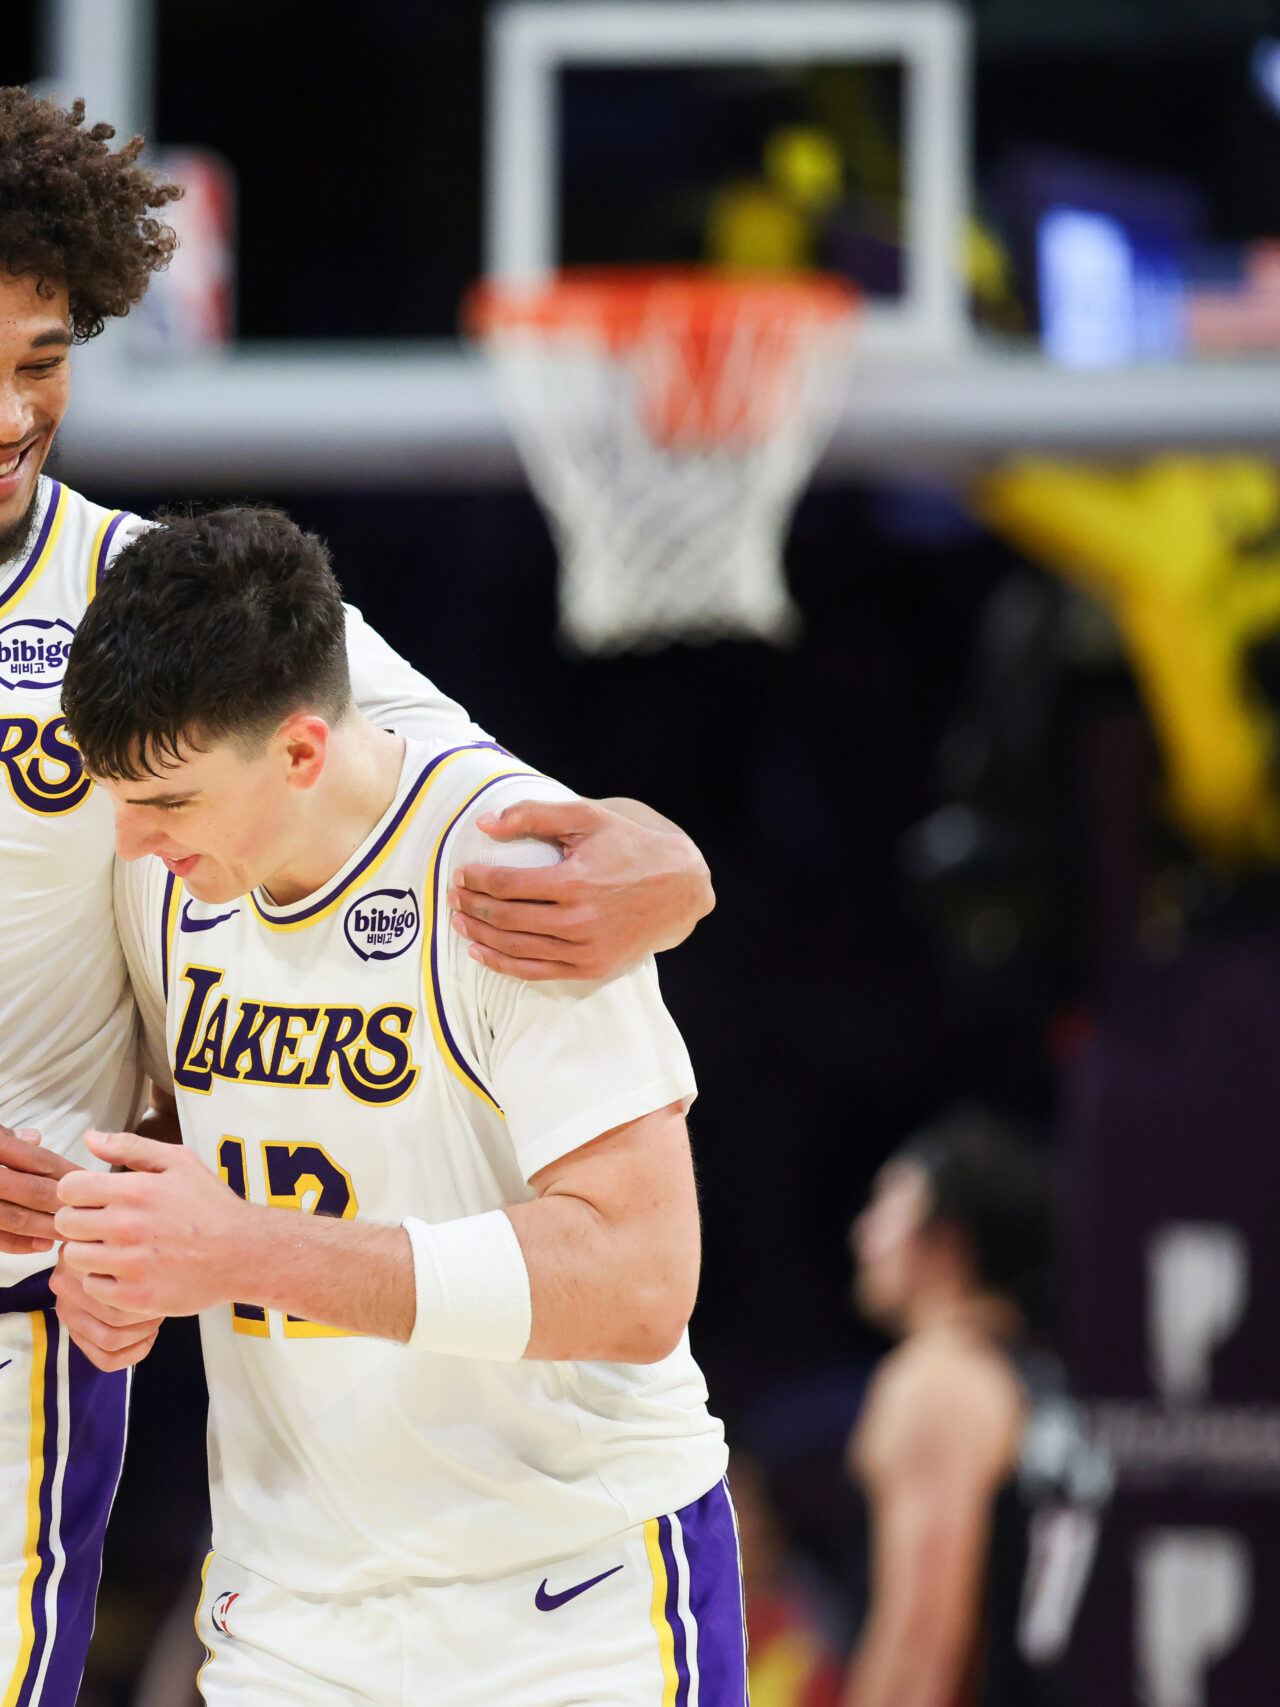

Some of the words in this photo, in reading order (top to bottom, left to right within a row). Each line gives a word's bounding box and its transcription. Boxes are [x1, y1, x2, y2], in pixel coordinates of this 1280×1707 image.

[10, 662, 46, 675] 비비고
[354, 907, 416, 938] bibigo
[366, 932, 393, 946] 비비고
[173, 962, 422, 1108] LAKERS
